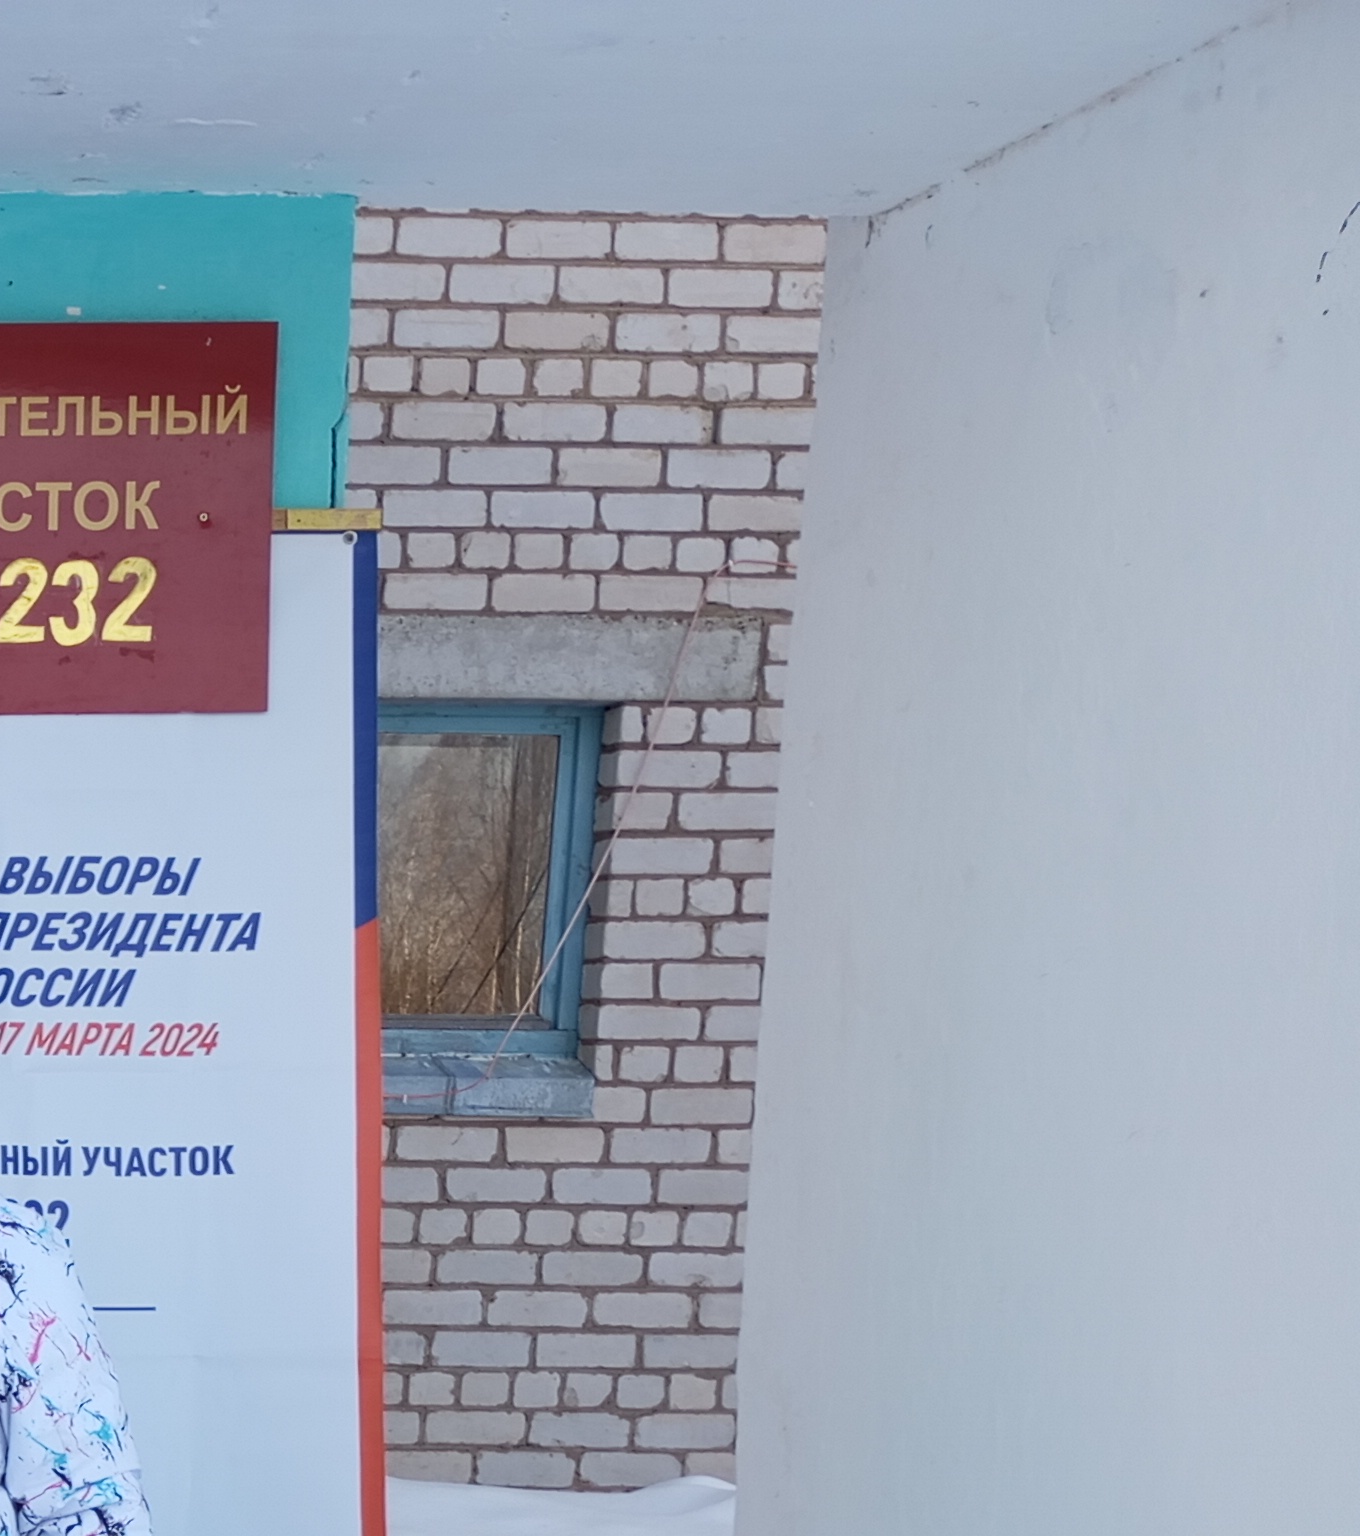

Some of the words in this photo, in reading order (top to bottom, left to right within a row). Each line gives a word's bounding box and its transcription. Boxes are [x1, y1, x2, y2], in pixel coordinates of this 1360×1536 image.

[24, 1021, 135, 1057] МАРТА
[138, 1021, 220, 1057] 2024
[81, 1144, 236, 1177] УЧАСТОК
